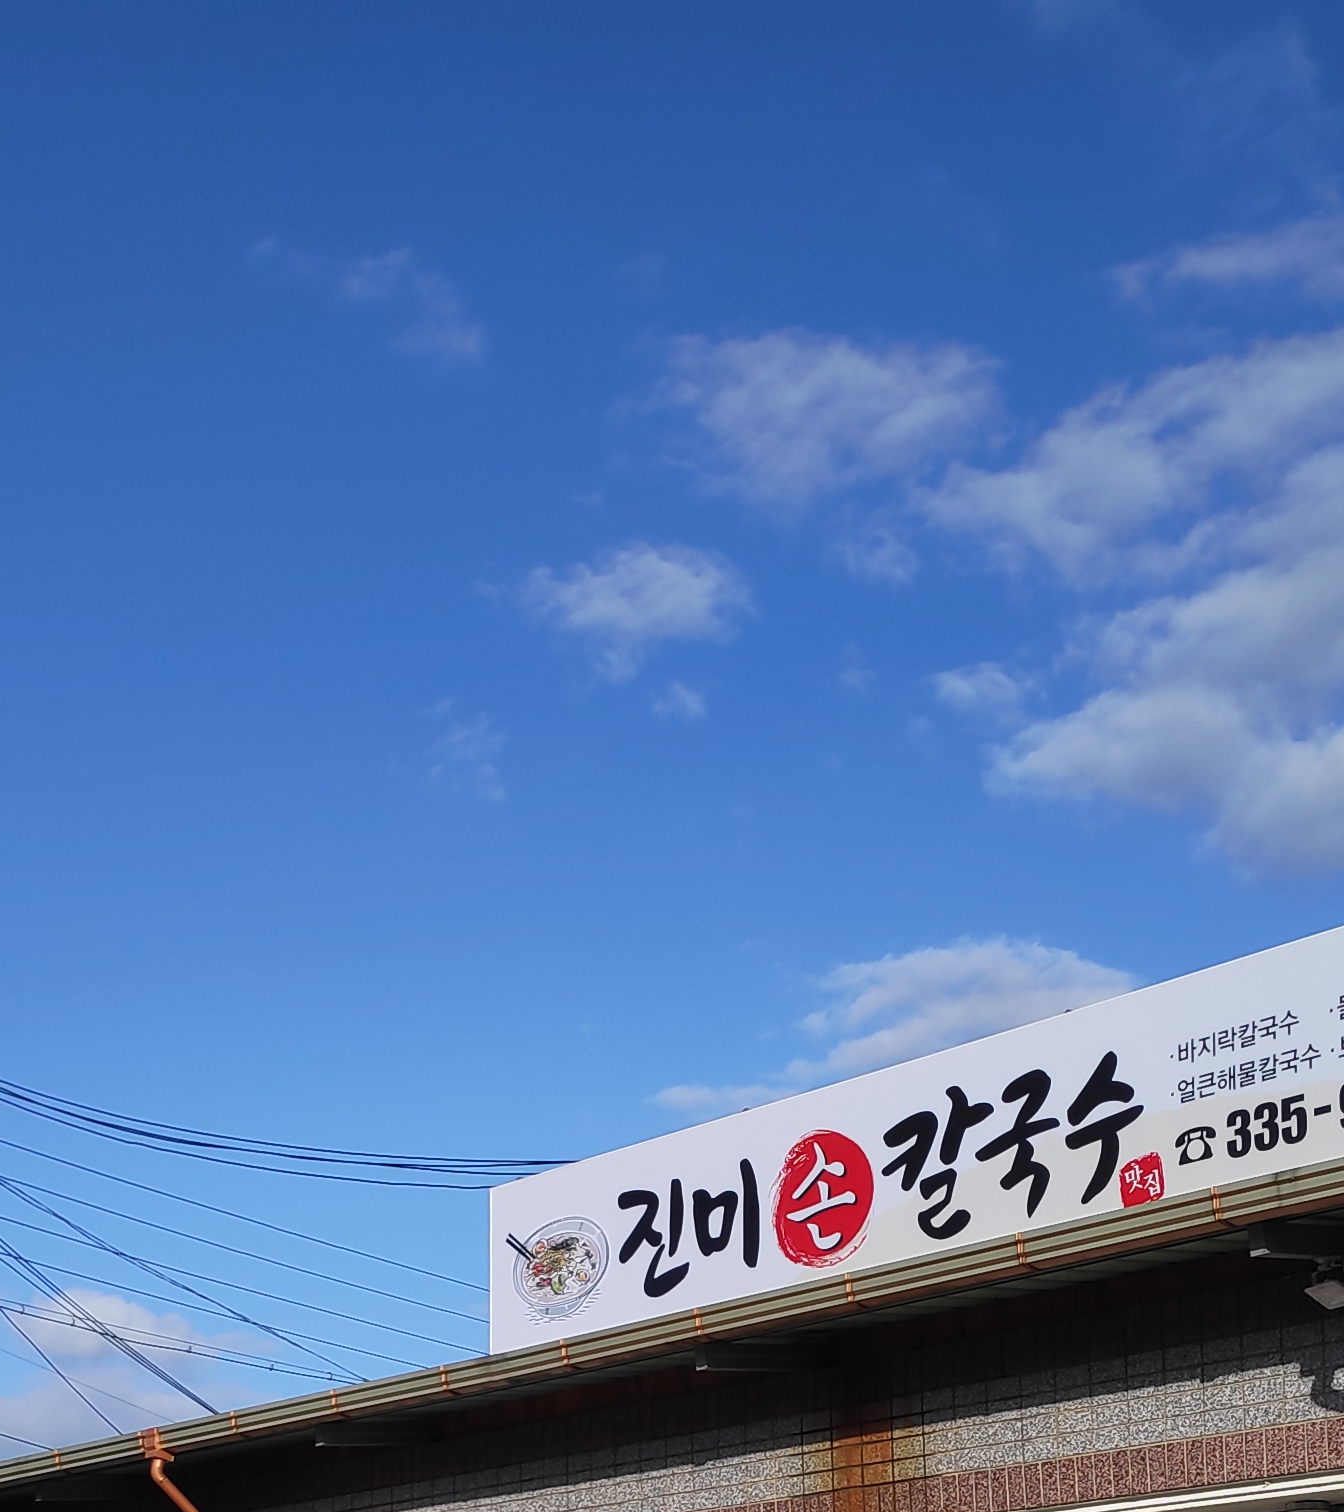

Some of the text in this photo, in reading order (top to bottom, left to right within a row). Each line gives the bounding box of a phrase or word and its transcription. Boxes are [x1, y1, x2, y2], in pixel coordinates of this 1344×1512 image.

[1177, 1009, 1300, 1064] 바지락칼국수
[1177, 1043, 1322, 1104] 얼큰해물칼국수
[1124, 1164, 1161, 1197] 맛집
